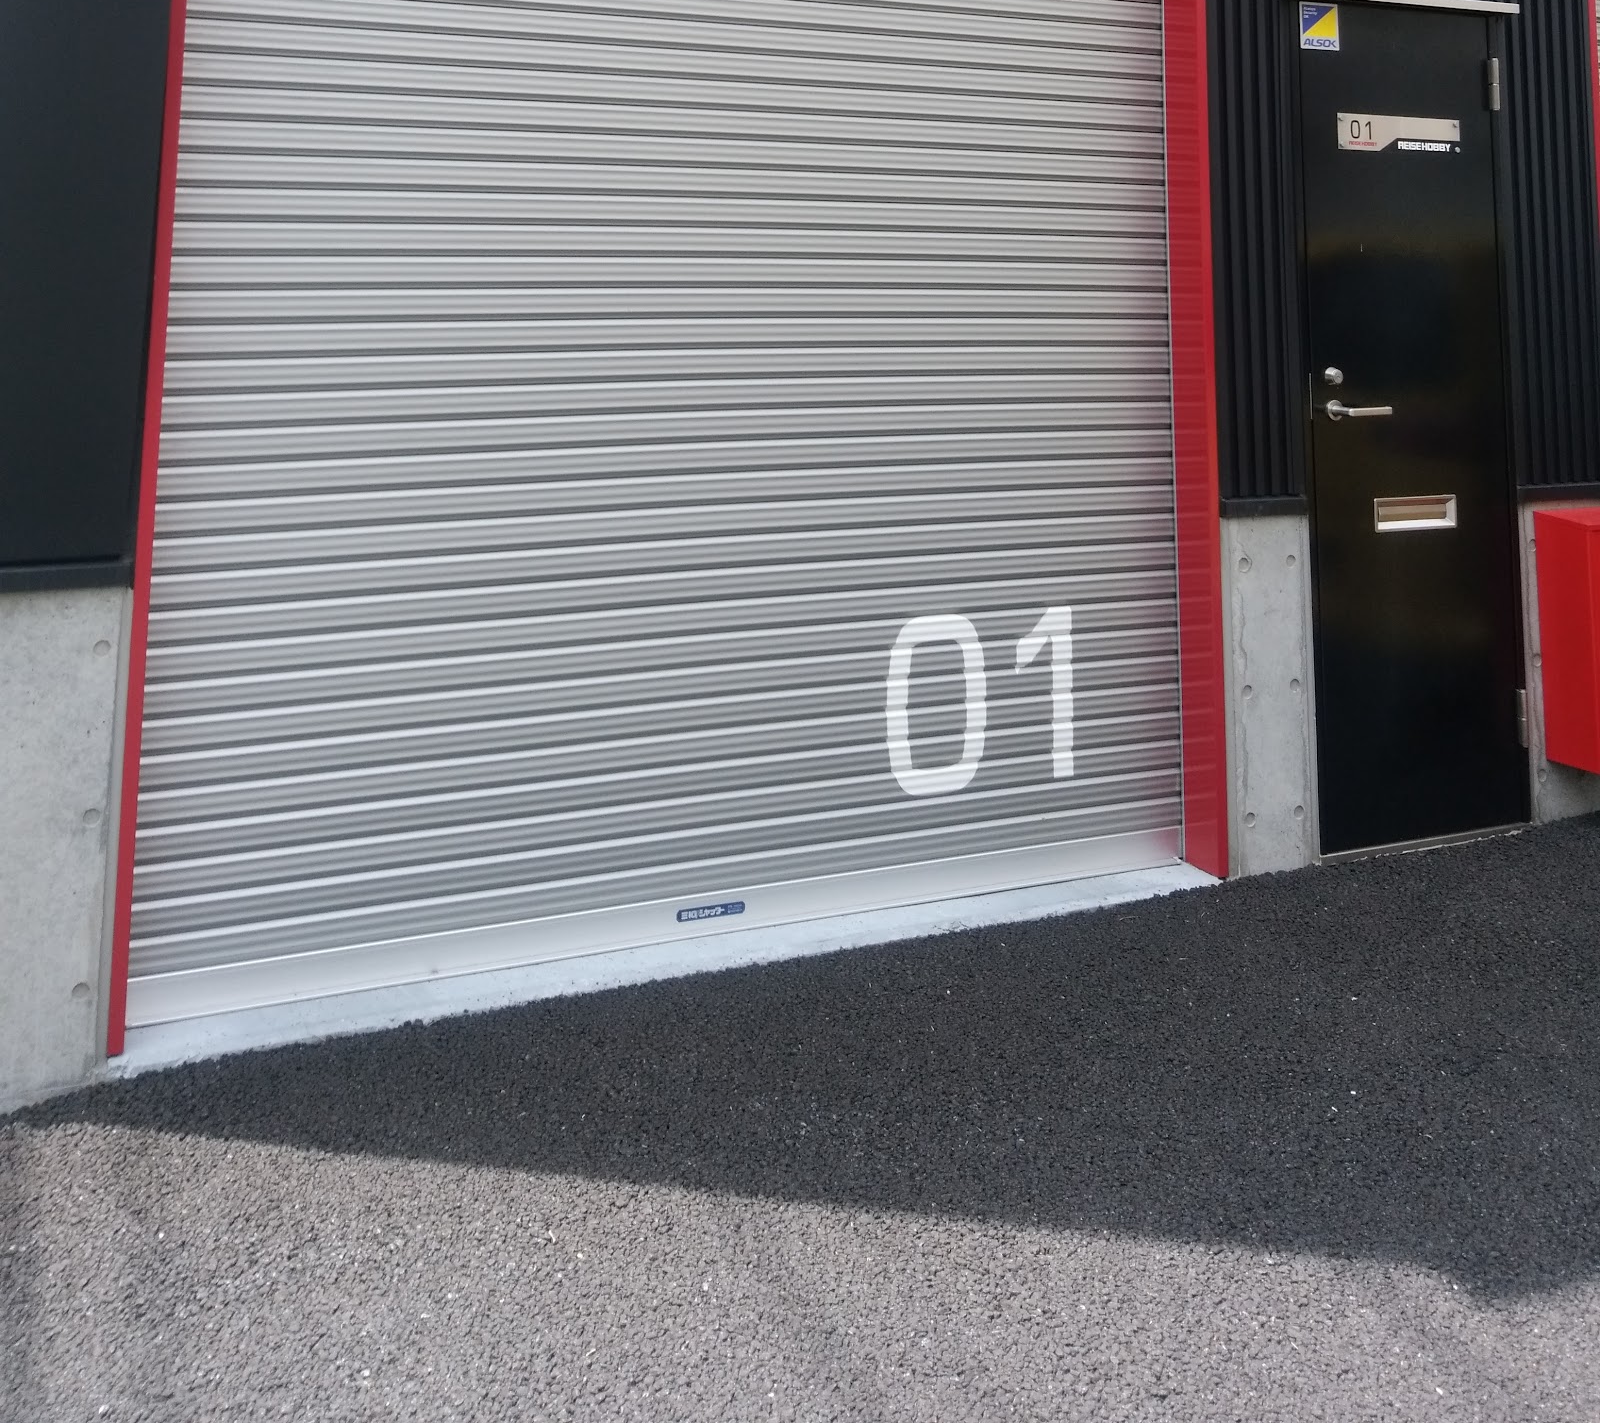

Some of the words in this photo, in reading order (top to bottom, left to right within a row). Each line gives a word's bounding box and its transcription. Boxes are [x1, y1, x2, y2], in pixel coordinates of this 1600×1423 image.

[1303, 38, 1337, 48] ALSOK
[1350, 119, 1372, 140] 01
[885, 605, 1075, 797] 01
